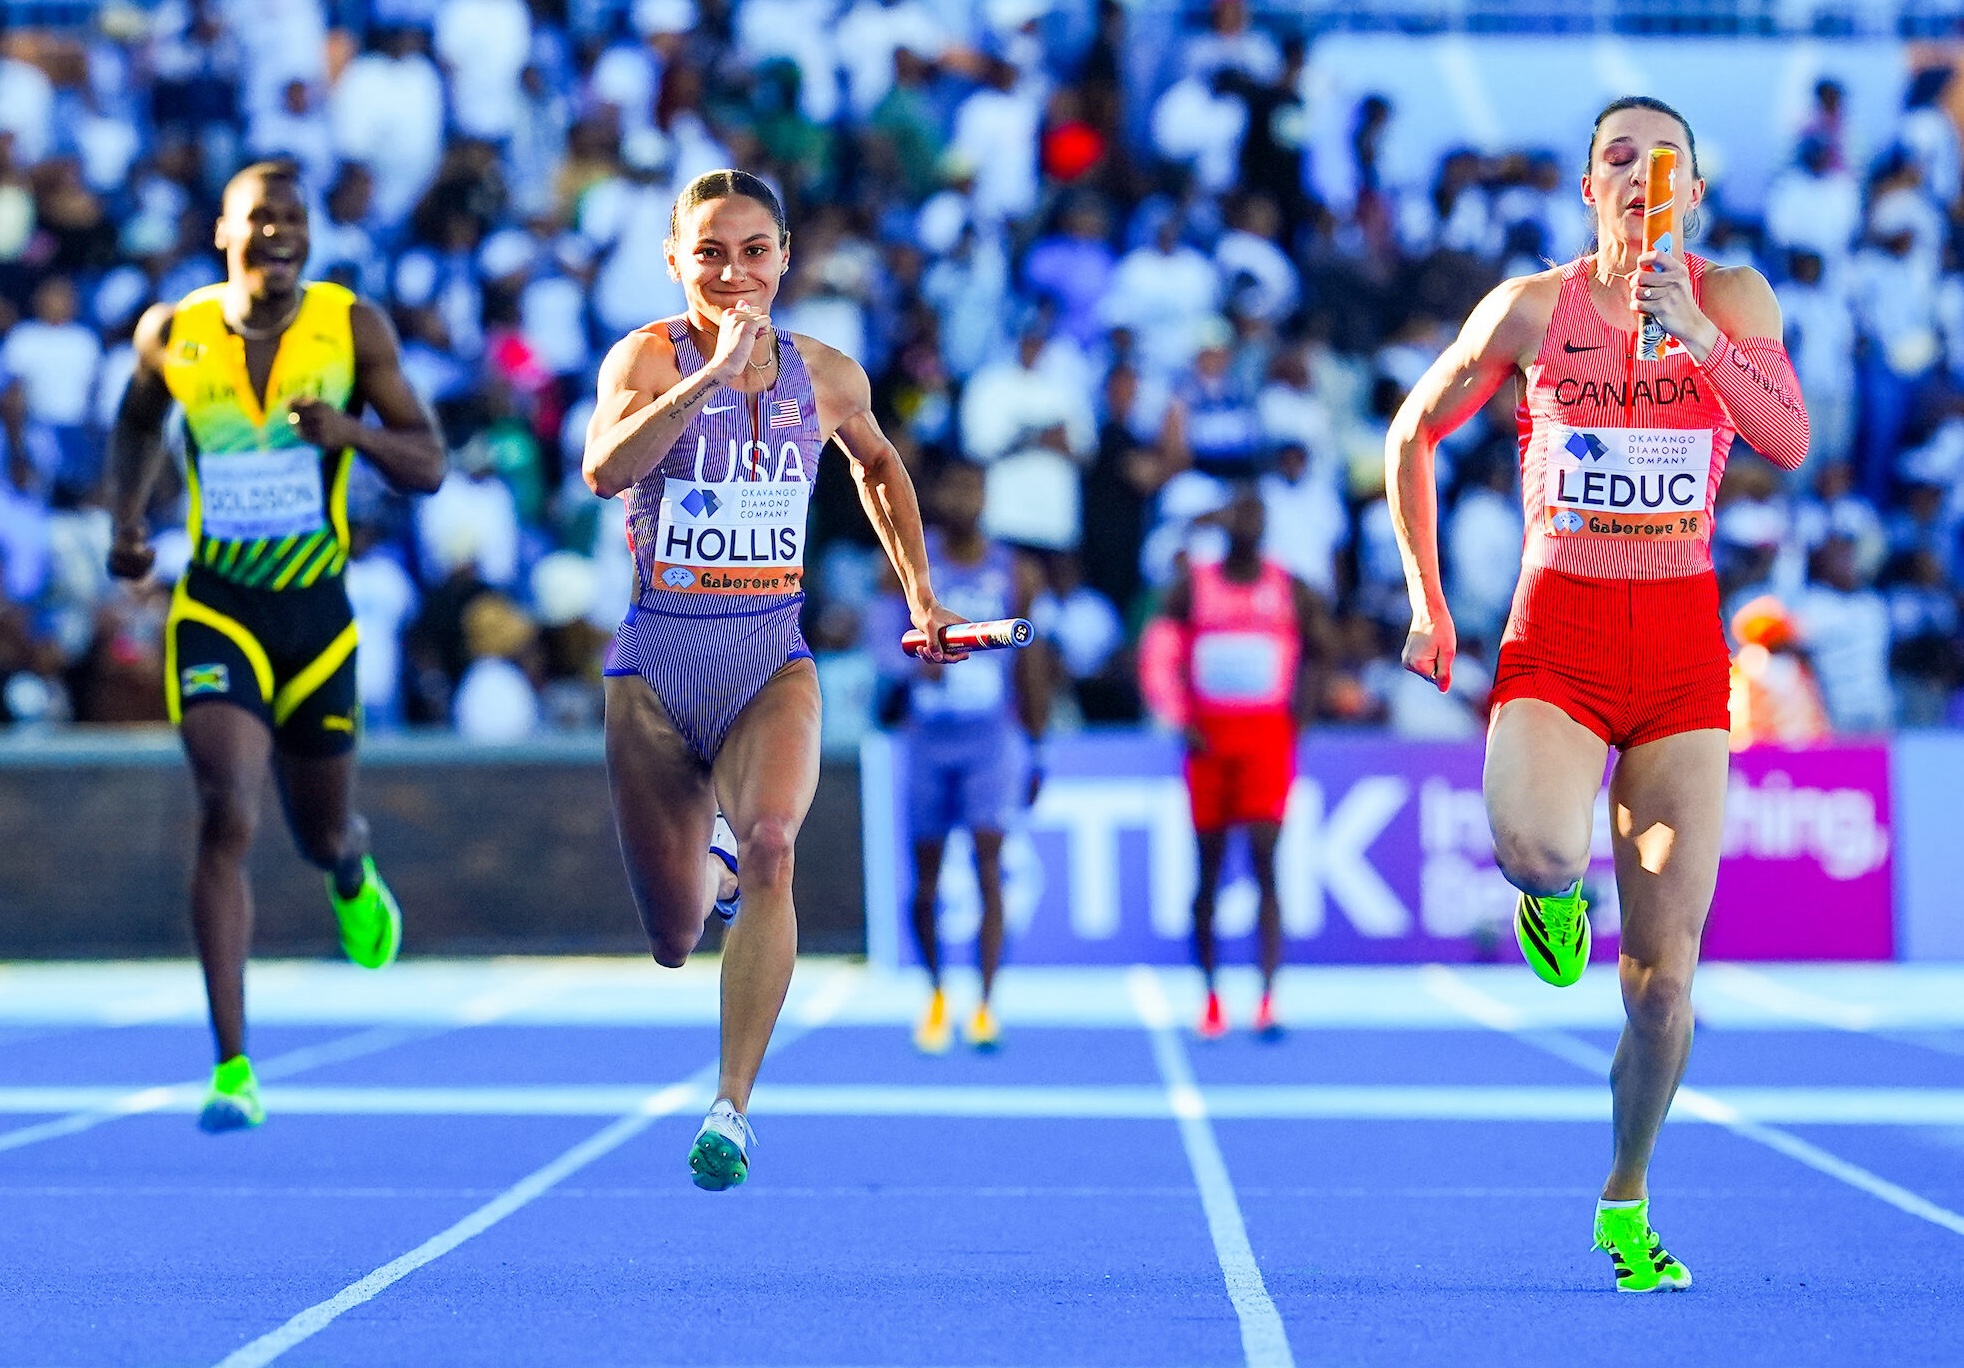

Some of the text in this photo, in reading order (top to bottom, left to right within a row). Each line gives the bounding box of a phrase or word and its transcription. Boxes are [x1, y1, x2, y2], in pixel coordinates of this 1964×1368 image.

[1555, 377, 1700, 407] CANADA
[1628, 434, 1696, 444] OKAVANGO
[1628, 446, 1688, 455] DIAMOND
[694, 435, 807, 483] USA
[1628, 456, 1687, 465] COMPANY
[741, 488, 797, 497] OKAVANGO
[1557, 469, 1696, 508] LEDUC
[741, 500, 790, 508] DIAMOND
[740, 510, 789, 519] COMPANY
[1589, 516, 1697, 535] Gaborone 26
[665, 525, 797, 561] HOLLIS
[701, 572, 779, 589] Gaborone
[1015, 625, 1027, 641] 35
